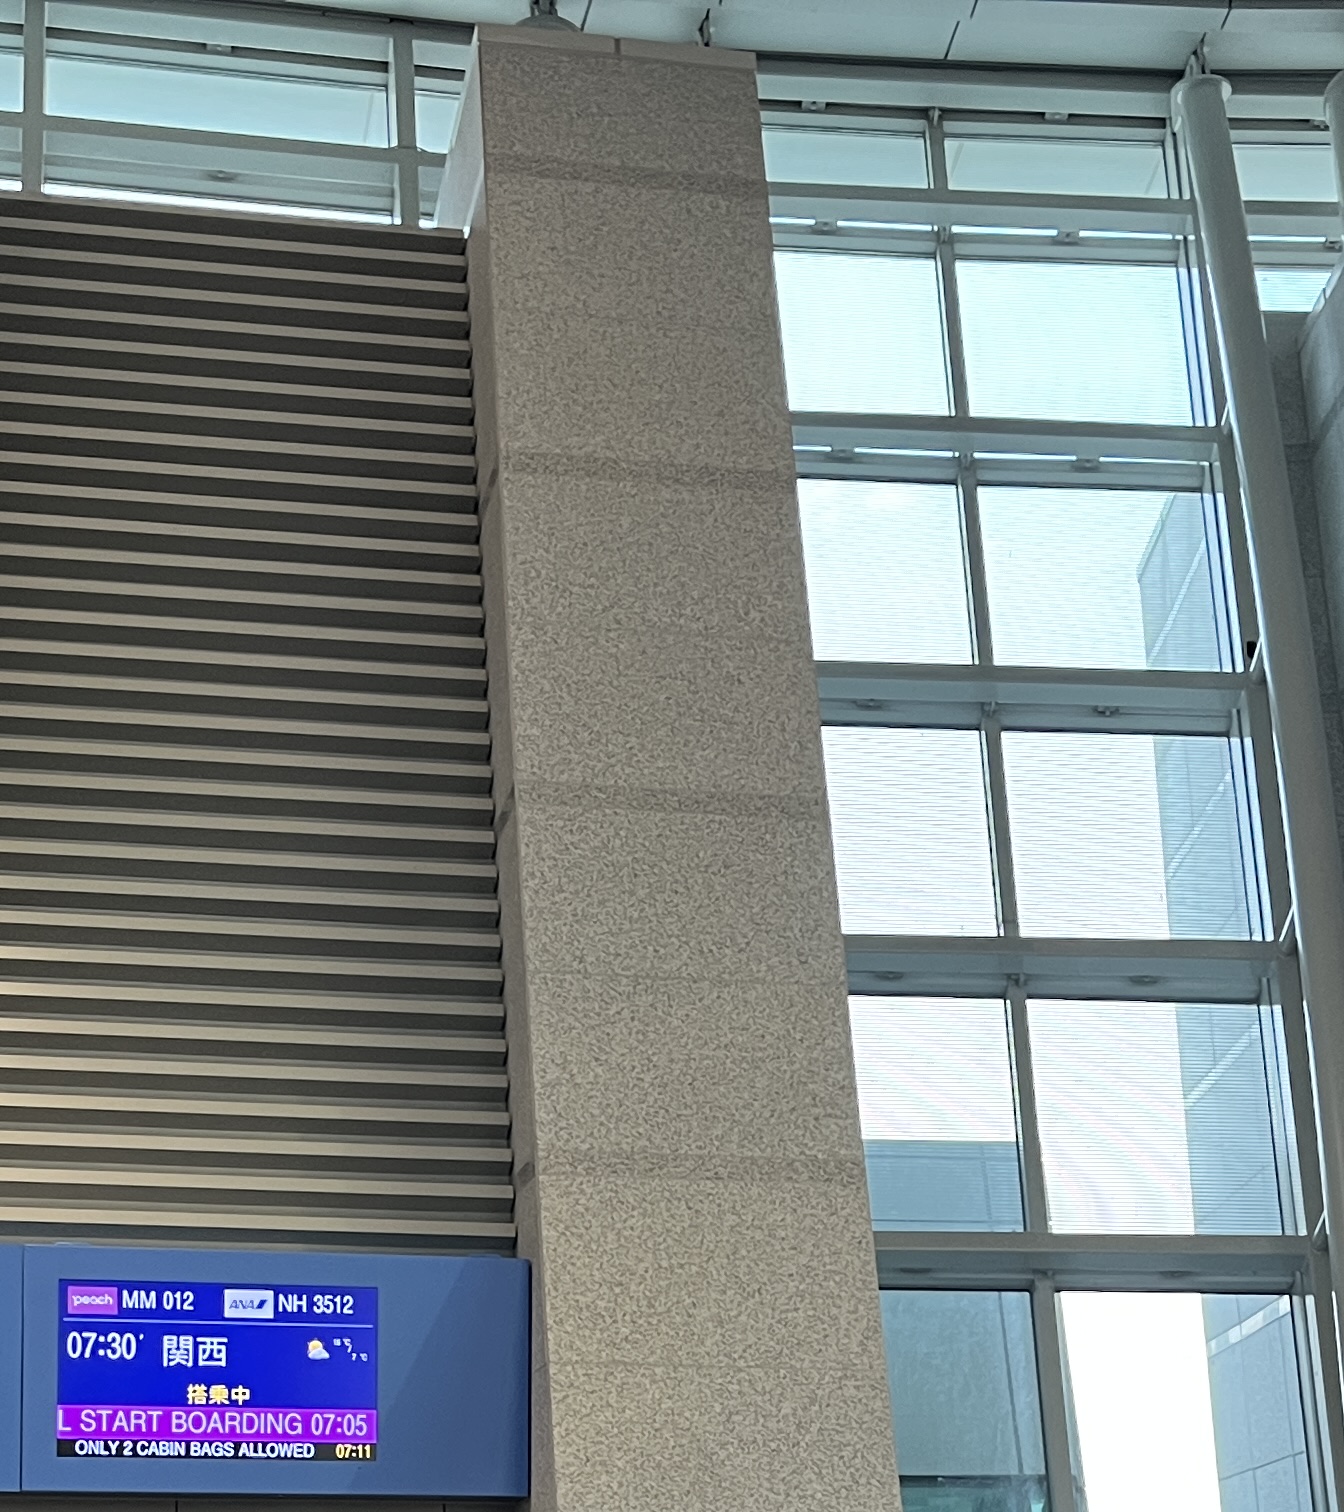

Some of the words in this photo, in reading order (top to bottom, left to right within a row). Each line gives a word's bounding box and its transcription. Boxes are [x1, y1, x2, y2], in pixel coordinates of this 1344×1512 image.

[72, 1293, 113, 1307] peach
[122, 1290, 156, 1310] MM
[163, 1291, 194, 1311] 012
[228, 1299, 255, 1310] ANA
[278, 1293, 307, 1313] NH
[313, 1294, 354, 1315] 3512
[163, 1335, 228, 1368] 関西
[187, 1384, 251, 1405] 搭乗中
[58, 1411, 72, 1432] L
[80, 1410, 163, 1432] START
[171, 1411, 303, 1436] BOARDING
[311, 1415, 367, 1436] 07:05
[75, 1440, 119, 1457] ONLY
[122, 1441, 133, 1456] 2
[136, 1441, 186, 1458] CABIN
[189, 1442, 235, 1458] BAGS
[238, 1442, 315, 1459] ALLOWED
[335, 1444, 371, 1459] 07:11
